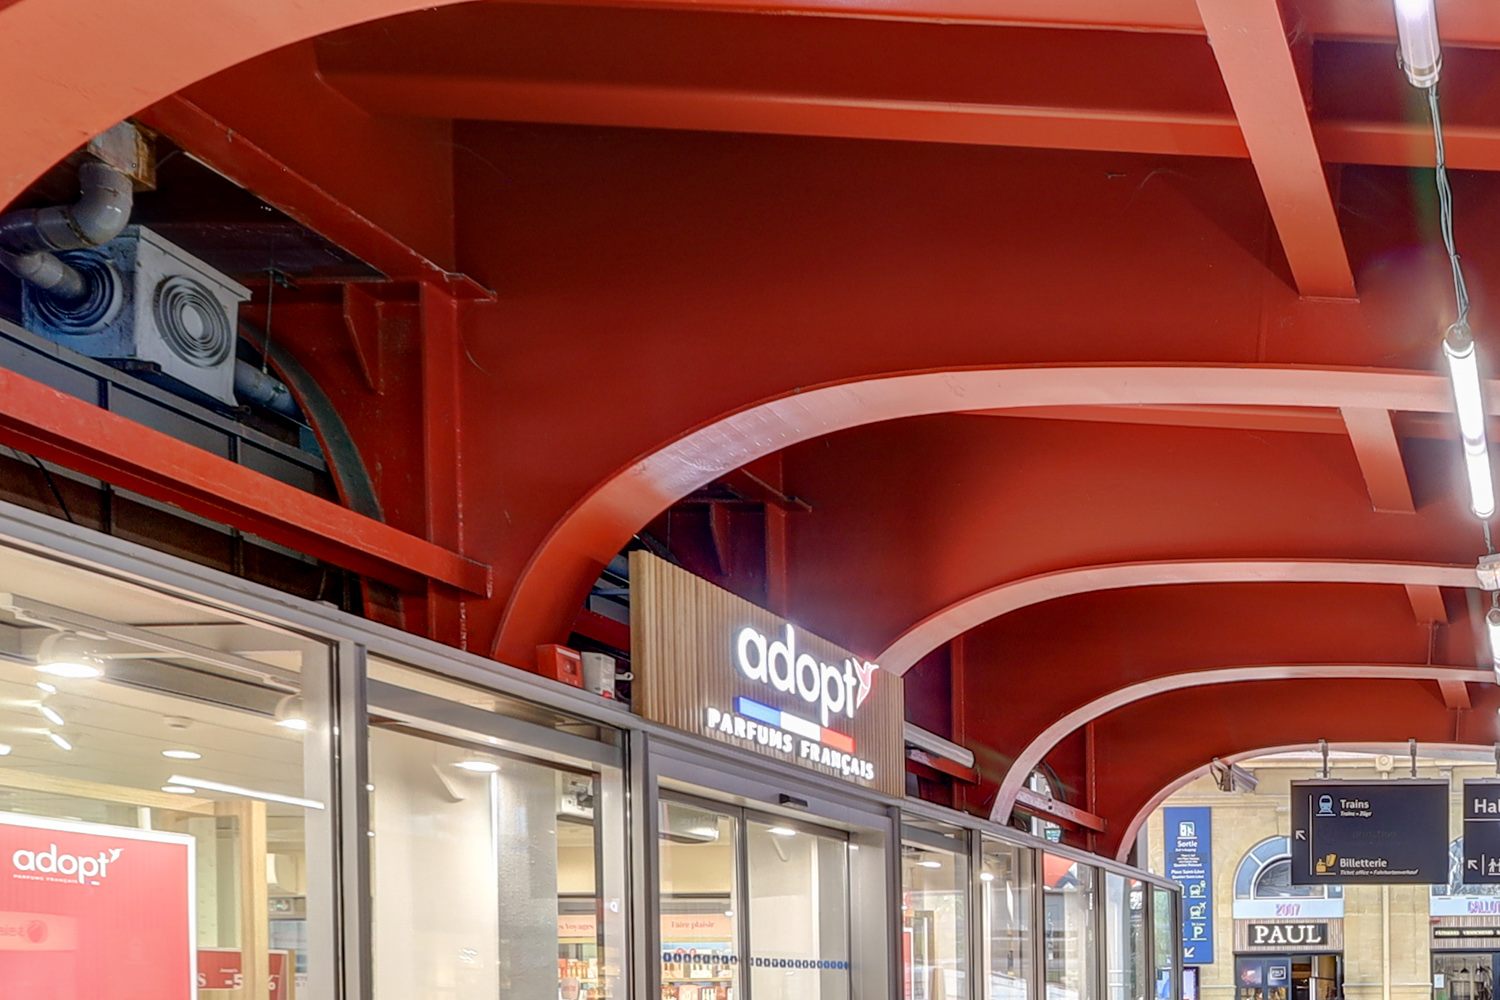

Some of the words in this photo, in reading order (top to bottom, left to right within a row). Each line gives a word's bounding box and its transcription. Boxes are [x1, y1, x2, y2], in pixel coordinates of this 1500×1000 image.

[737, 623, 857, 727] adopt
[706, 707, 793, 753] PARFUMS
[800, 740, 875, 780] FRANÇAIS
[1340, 799, 1369, 809] Trains
[1177, 840, 1198, 848] Sortie
[12, 843, 110, 884] adopt
[1340, 858, 1388, 868] Billetterie
[1276, 904, 1301, 916] 2007
[691, 920, 715, 930] plaisir
[1254, 925, 1321, 944] PAUL
